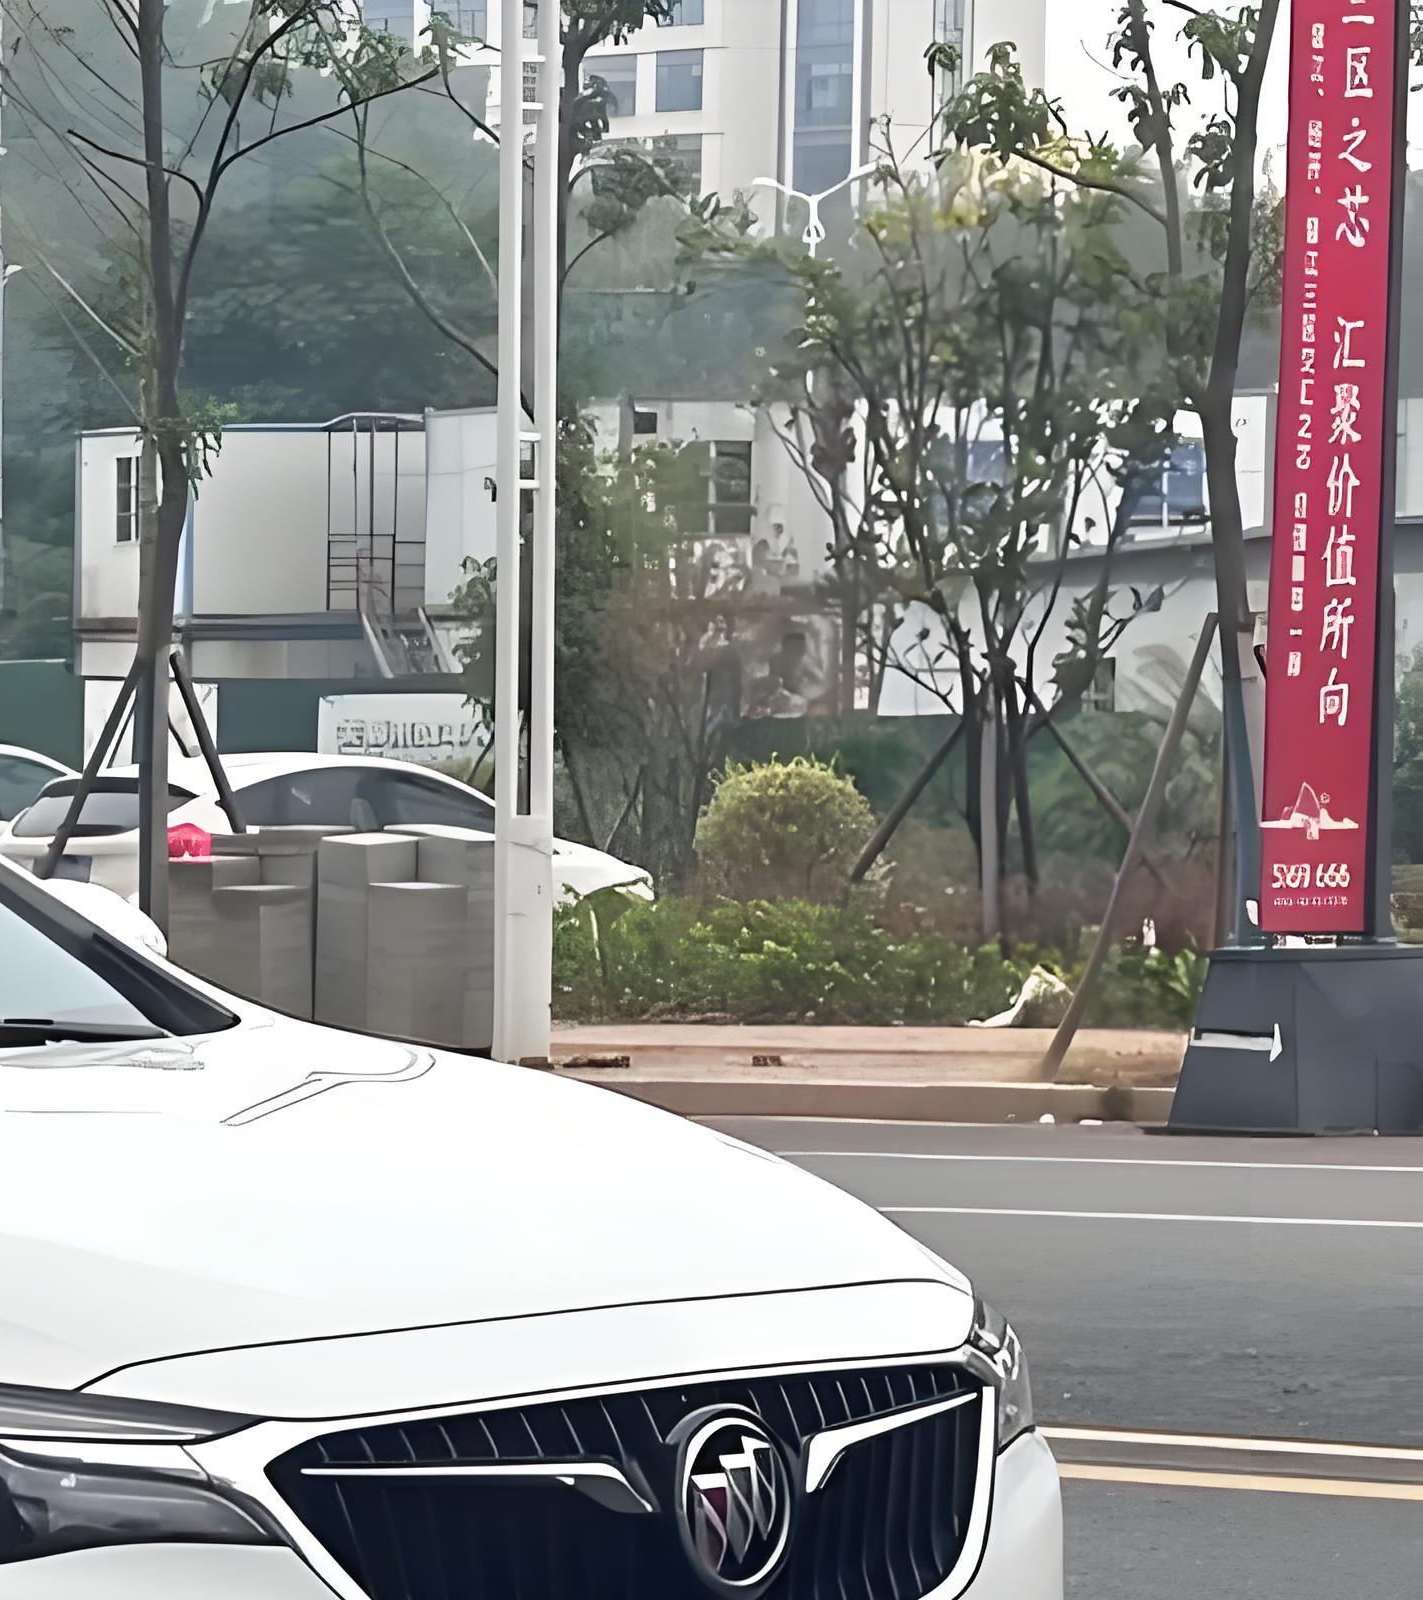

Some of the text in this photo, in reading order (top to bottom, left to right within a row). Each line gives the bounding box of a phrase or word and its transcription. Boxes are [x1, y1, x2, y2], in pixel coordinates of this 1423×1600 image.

[1319, 316, 1366, 727] 汇聚价值所向
